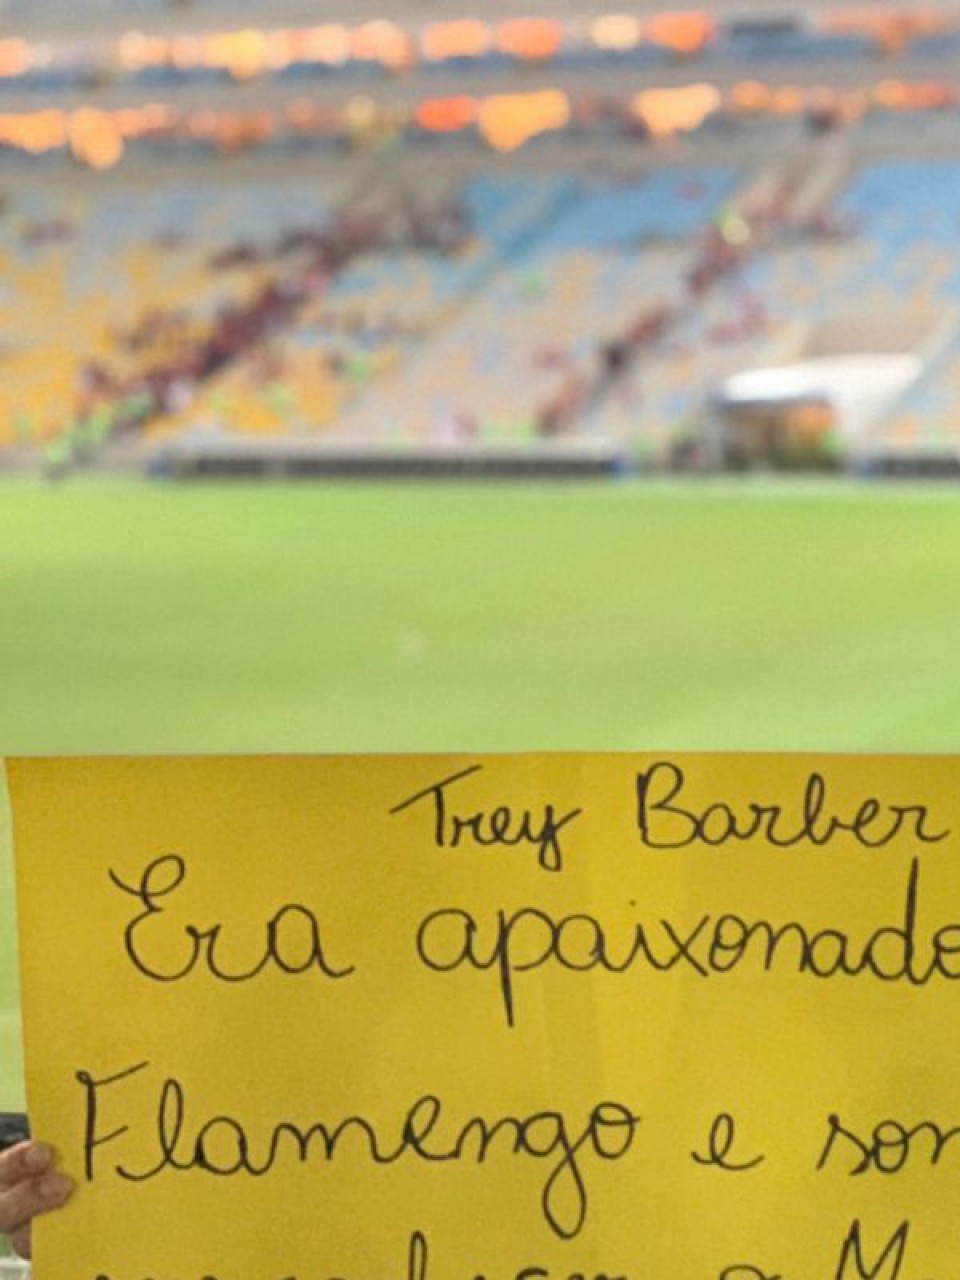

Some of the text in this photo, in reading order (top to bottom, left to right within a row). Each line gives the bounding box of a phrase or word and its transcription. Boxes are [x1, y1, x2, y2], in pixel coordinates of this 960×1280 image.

[389, 761, 950, 873] Trey Barber
[108, 853, 356, 983] Era
[75, 1061, 641, 1241] Flamengo
[690, 1112, 765, 1171] e
